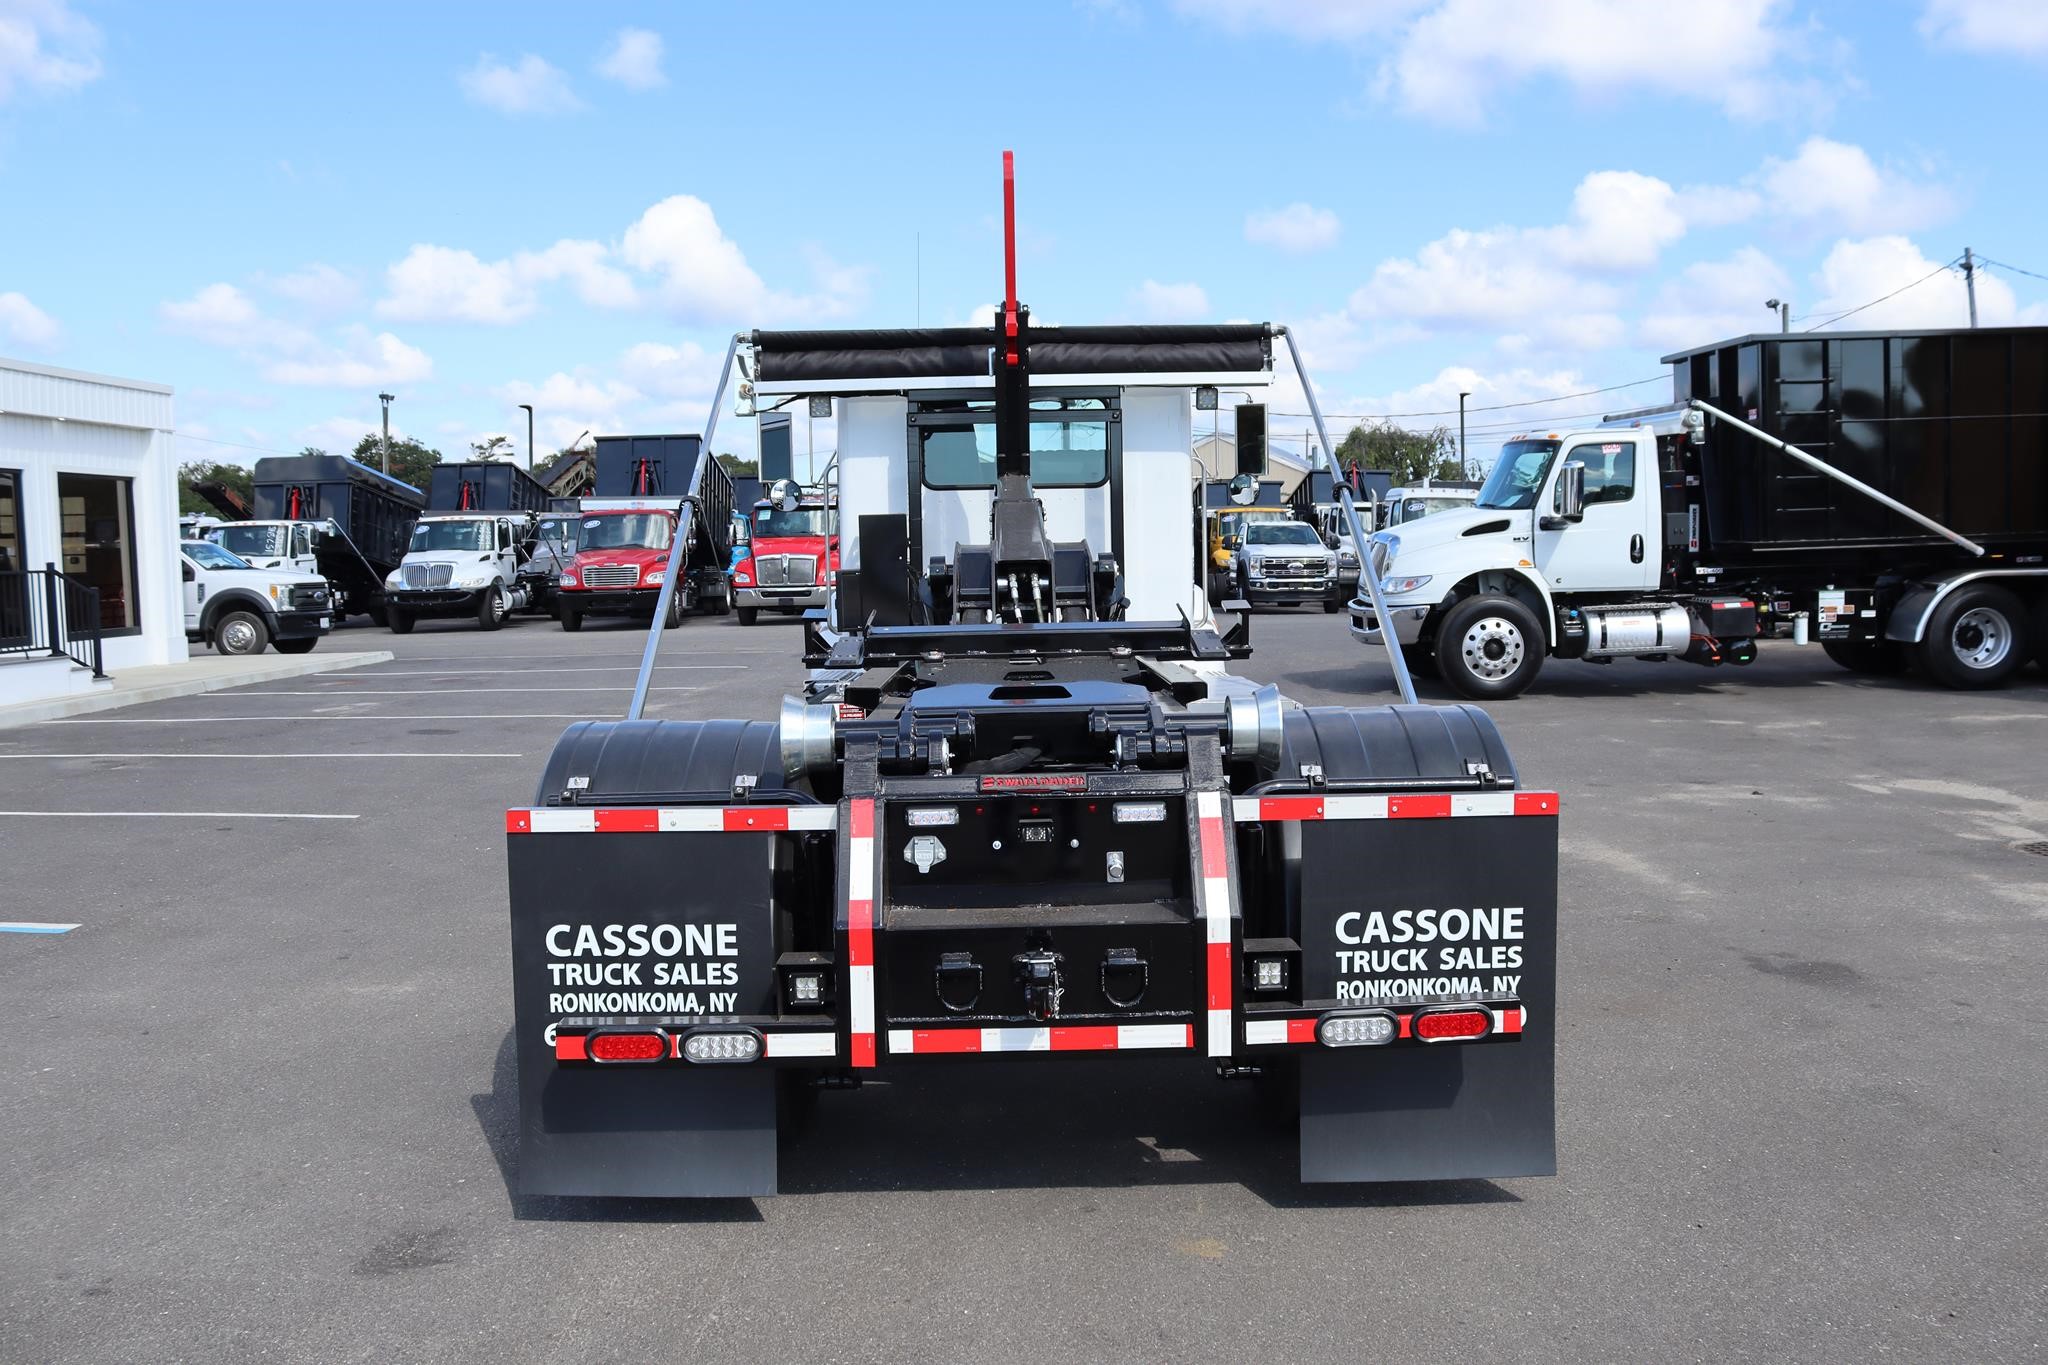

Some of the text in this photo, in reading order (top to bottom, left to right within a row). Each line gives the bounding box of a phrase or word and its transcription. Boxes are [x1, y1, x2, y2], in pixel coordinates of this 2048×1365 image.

[997, 775, 1084, 787] SWAPLOADER
[1335, 907, 1524, 945] CASSONE
[546, 923, 738, 957] CASSONE
[1336, 945, 1523, 974] TRUCK SALES
[547, 962, 738, 986] TRUCK SALES
[1336, 975, 1522, 1000] RONKONKOMA NY
[550, 992, 737, 1015] RONKONKOMA, NY
